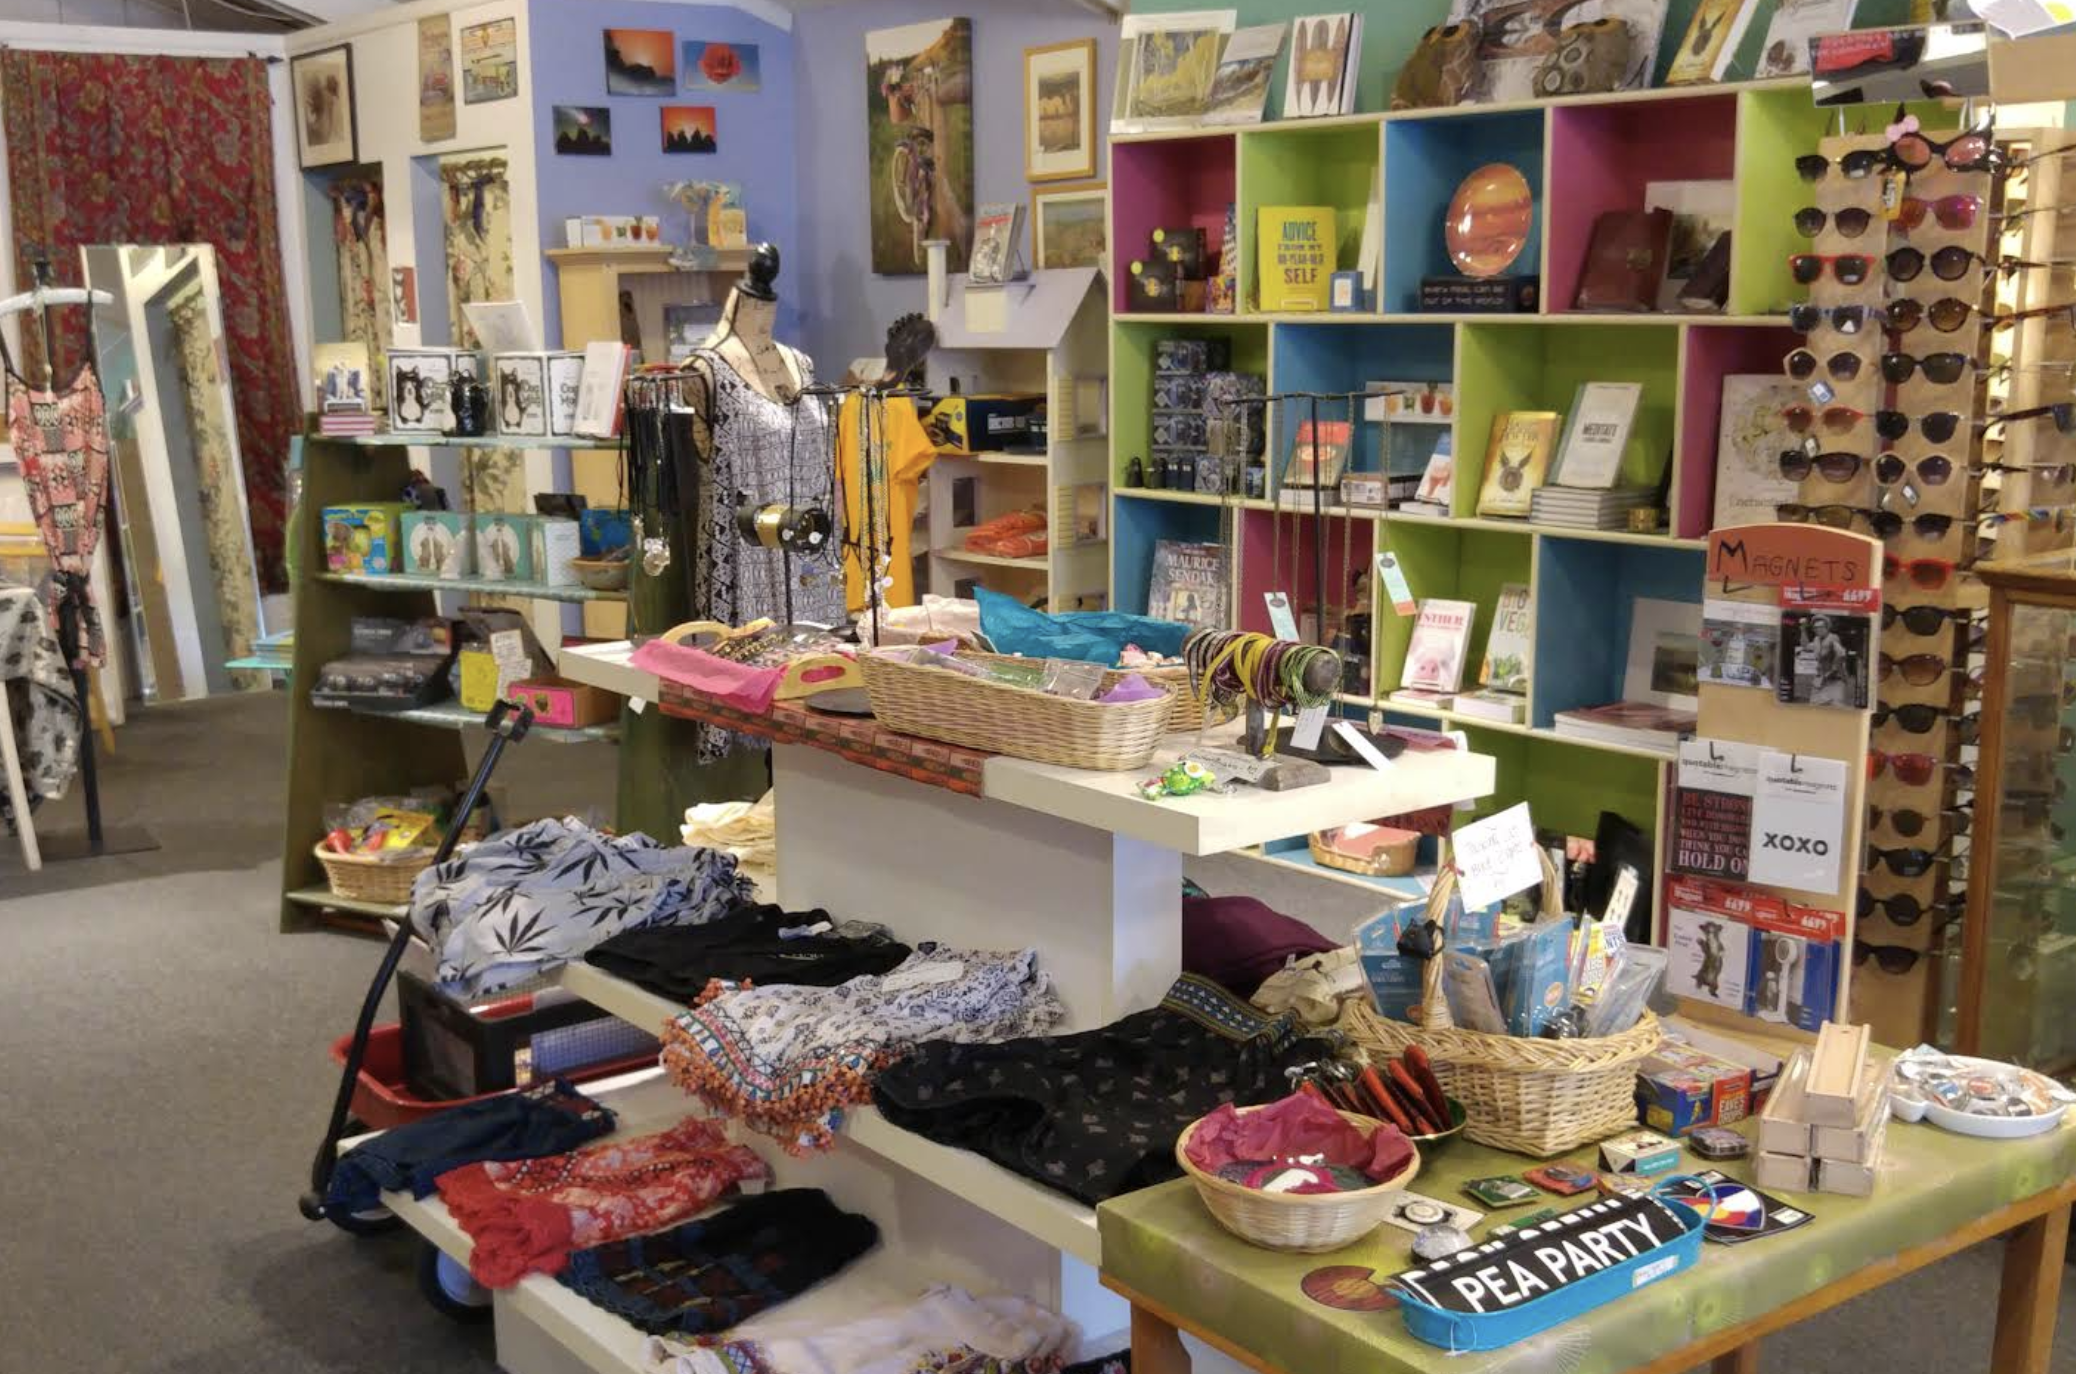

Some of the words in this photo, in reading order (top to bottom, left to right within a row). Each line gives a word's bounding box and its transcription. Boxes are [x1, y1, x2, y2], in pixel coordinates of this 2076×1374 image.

[1284, 268, 1318, 284] SELF
[1166, 554, 1220, 571] MAURICE
[1717, 539, 1859, 582] MAGNETS
[1168, 569, 1215, 586] SENDAK
[1680, 838, 1714, 853] THINK
[1678, 850, 1725, 871] HOLD
[1451, 1261, 1549, 1313] PEA
[1534, 1212, 1662, 1284] PARTY
